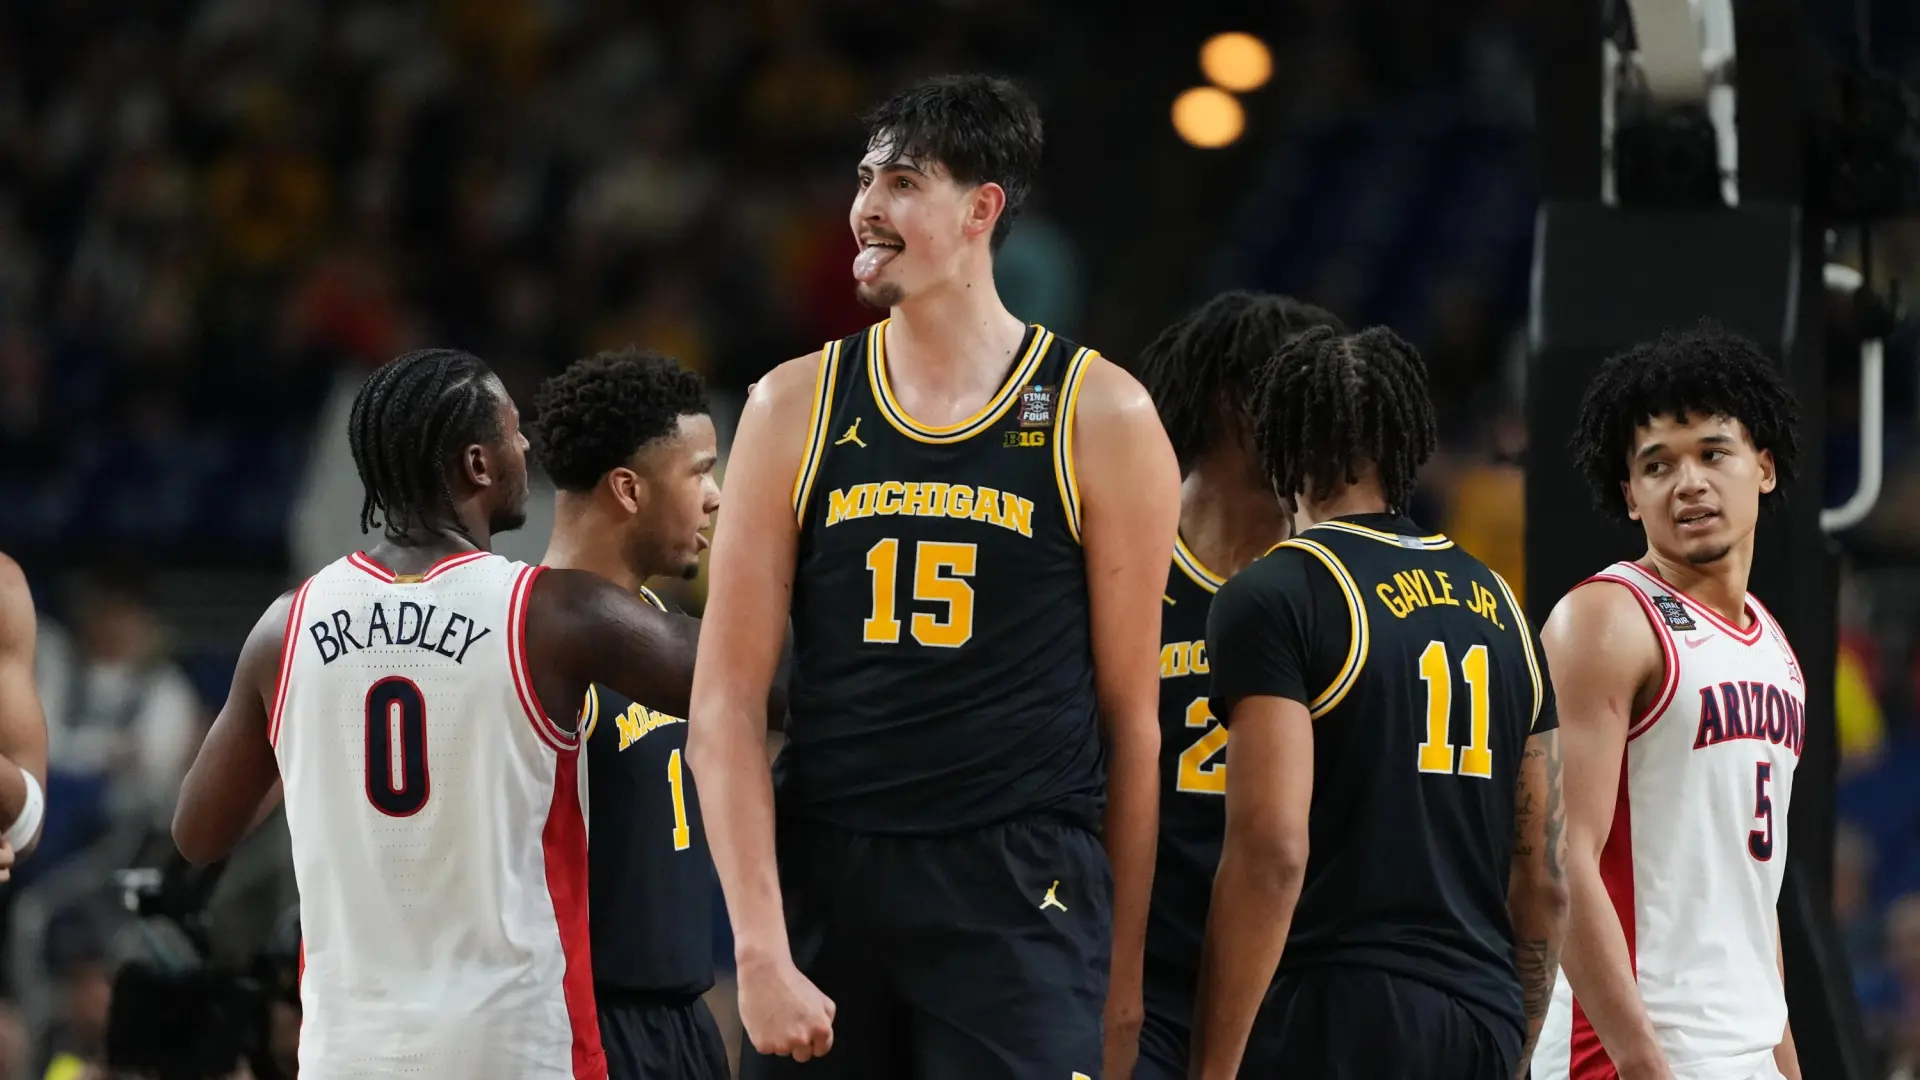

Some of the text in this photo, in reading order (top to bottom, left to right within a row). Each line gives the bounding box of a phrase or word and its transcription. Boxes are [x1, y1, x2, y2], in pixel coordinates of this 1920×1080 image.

[1023, 392, 1050, 402] FINAL
[1023, 411, 1049, 421] FOUR
[825, 481, 1035, 538] MICHIGAN
[863, 538, 977, 648] 15
[1376, 568, 1505, 631] GAYLE JR.
[1659, 601, 1681, 610] FINAL
[1669, 616, 1690, 625] FOUR
[309, 600, 491, 665] BRADLEY
[1417, 640, 1492, 779] 11
[365, 675, 430, 817] 0
[667, 748, 690, 851] 1
[1748, 761, 1773, 862] 5
